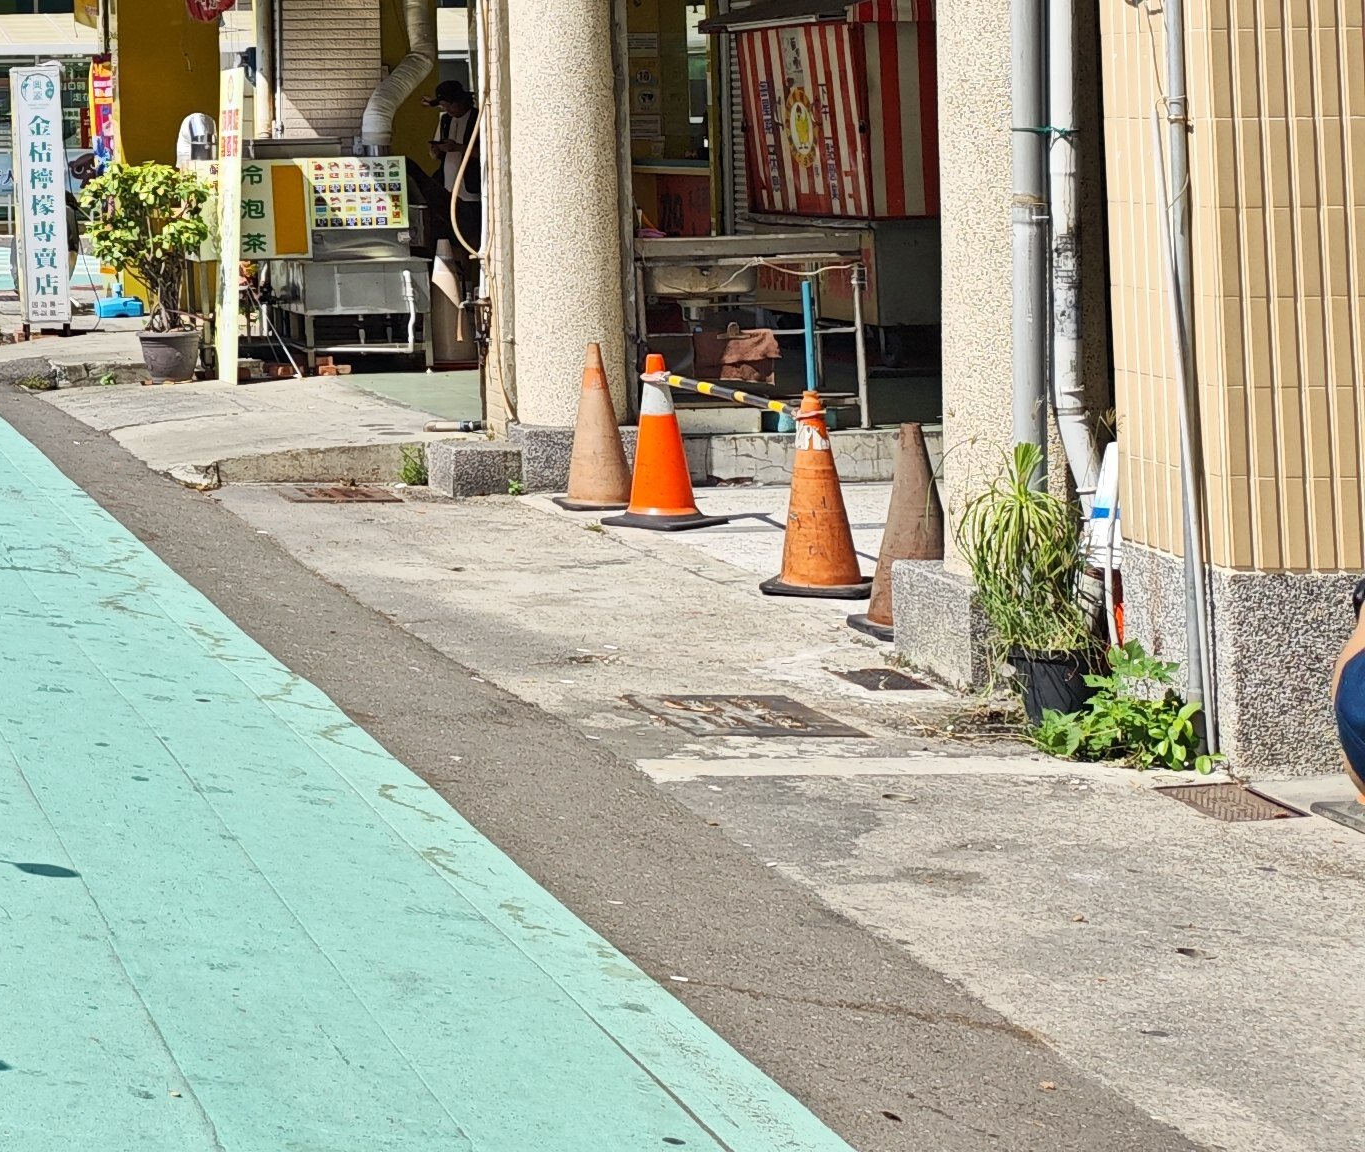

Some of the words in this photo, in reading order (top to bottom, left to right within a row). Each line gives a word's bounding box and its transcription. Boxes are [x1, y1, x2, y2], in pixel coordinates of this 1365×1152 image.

[28, 115, 58, 296] 金桔檸檬專賣店
[241, 164, 267, 254] 冷泡茶
